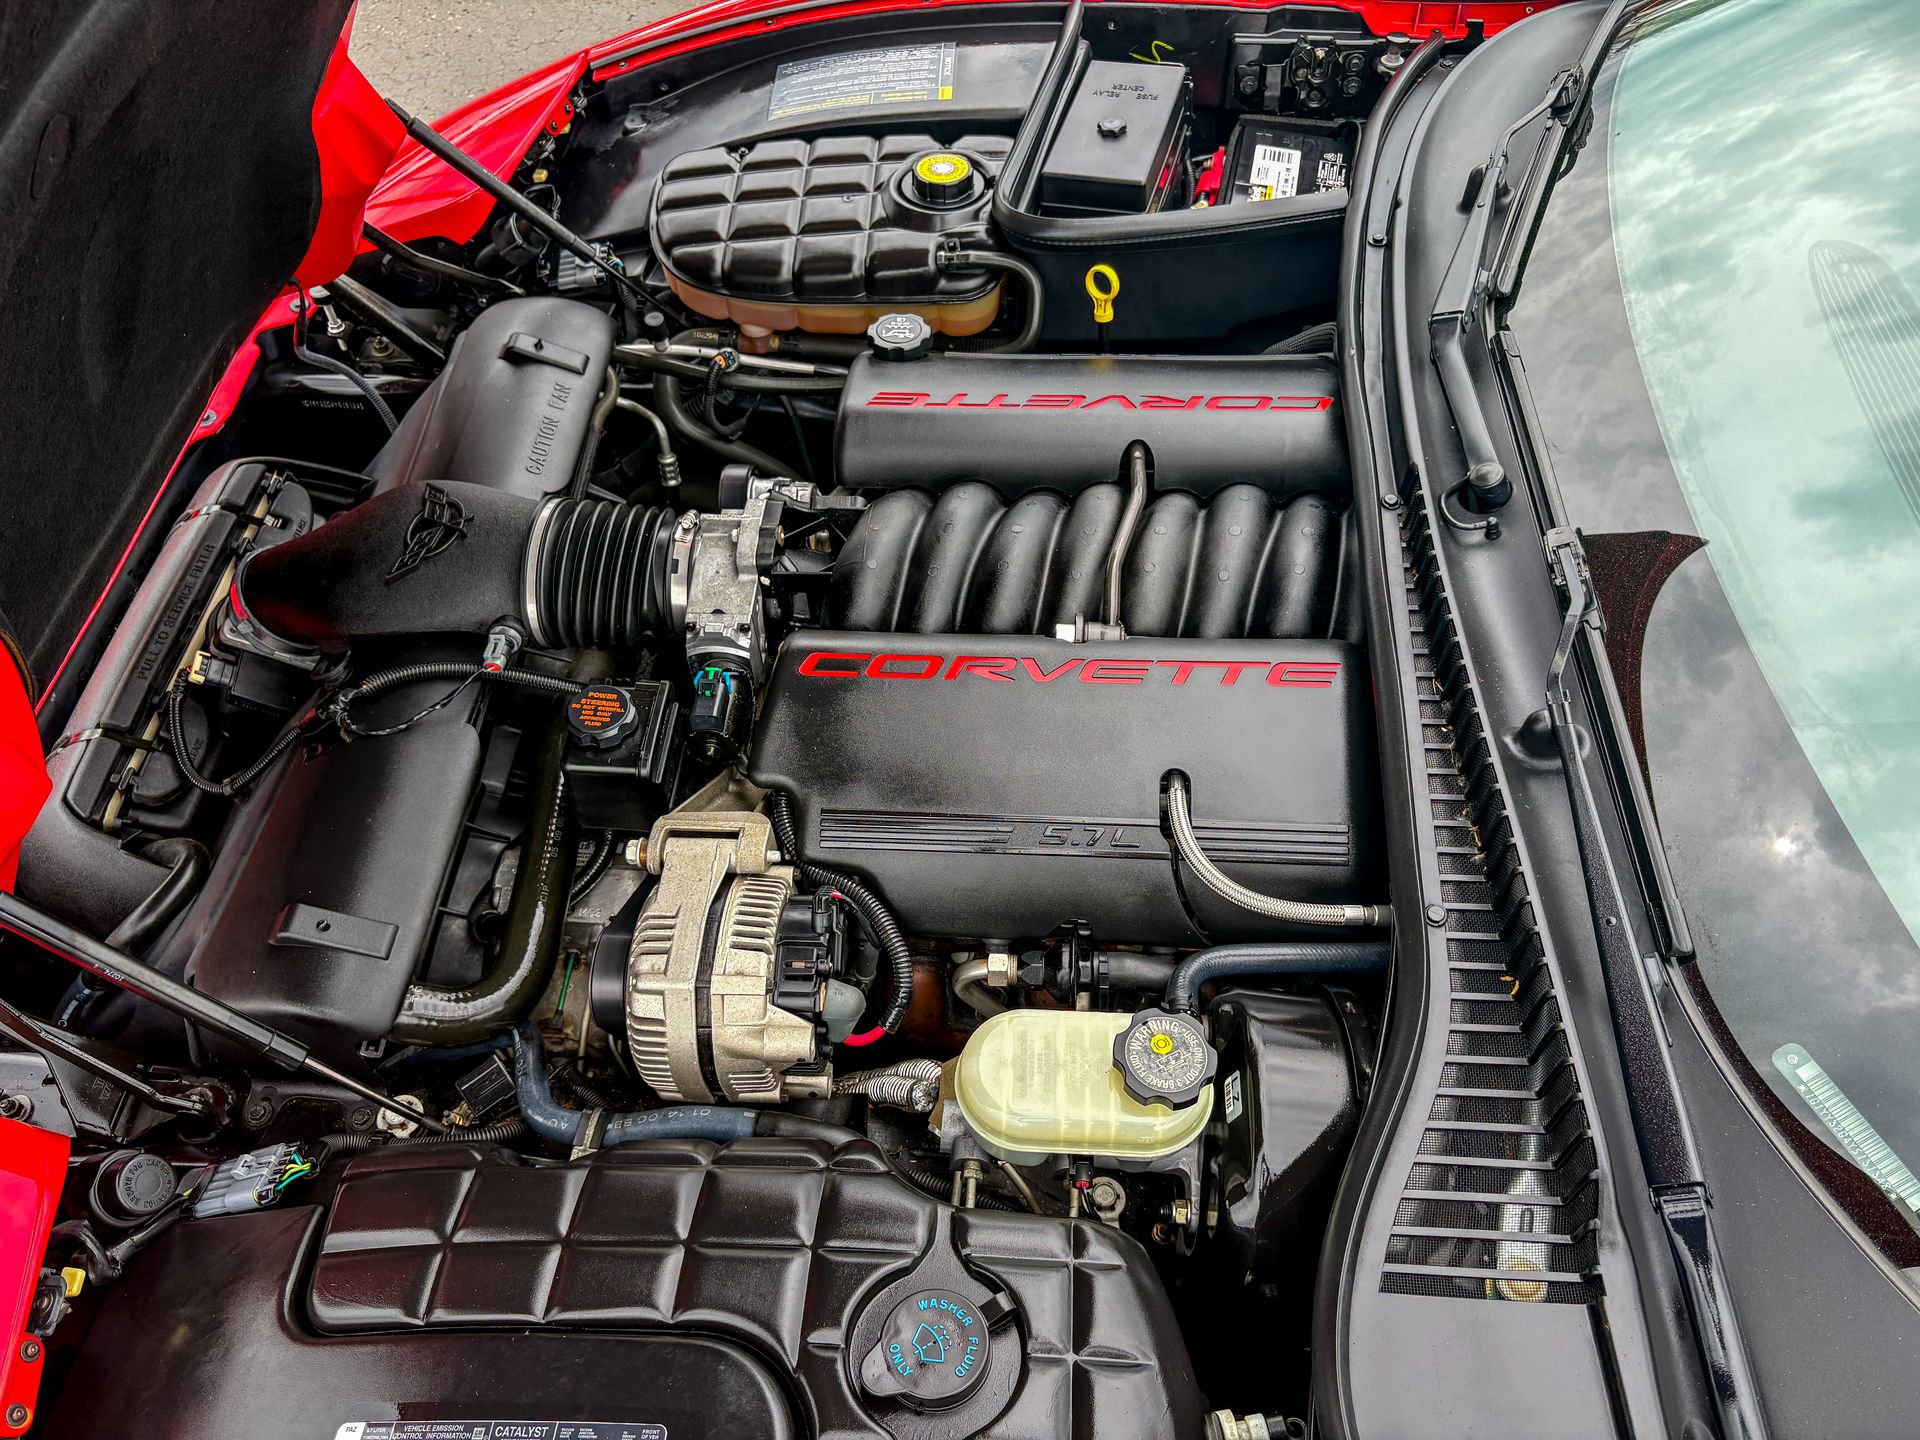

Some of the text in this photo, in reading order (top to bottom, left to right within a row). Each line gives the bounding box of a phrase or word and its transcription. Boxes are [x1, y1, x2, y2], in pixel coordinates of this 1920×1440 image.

[1092, 90, 1120, 98] RELAY
[1112, 84, 1145, 92] CENTER
[865, 391, 1335, 412] CORVETTE
[526, 382, 572, 475] CAUTION FAN
[136, 543, 216, 682] PULL TO SERVICE FILTER
[797, 651, 1342, 688] CORVETTE
[580, 698, 620, 707] STEERING
[588, 691, 618, 700] POWER
[1038, 825, 1140, 849] 5.7L
[1129, 1019, 1180, 1050] WARNING
[1184, 1030, 1199, 1047] USE
[1129, 1055, 1149, 1078] FLUID
[1193, 1047, 1206, 1071] ONLY
[1145, 1073, 1176, 1089] BRAKE
[1183, 1069, 1199, 1085] DOT
[888, 1298, 979, 1378] WASHER FLUID ONLY
[392, 1432, 423, 1440] CONTROL
[426, 1432, 472, 1440] INFORMATION
[495, 1426, 549, 1438] CATALYST
